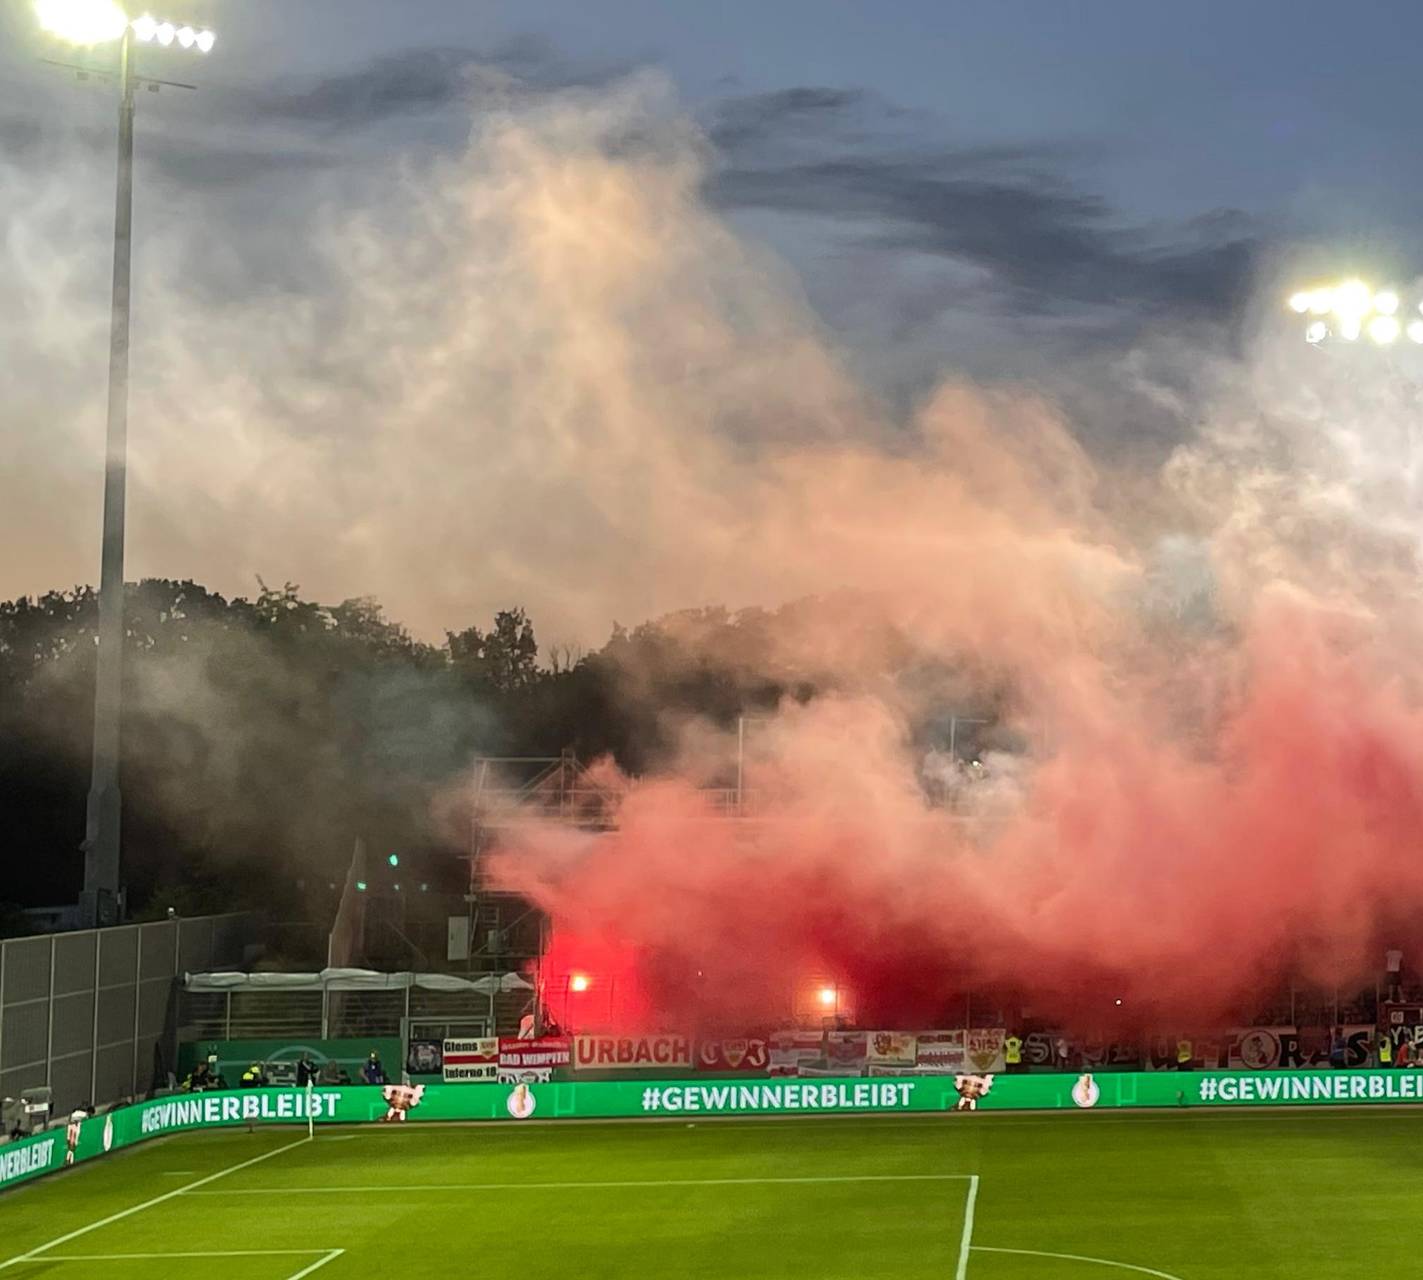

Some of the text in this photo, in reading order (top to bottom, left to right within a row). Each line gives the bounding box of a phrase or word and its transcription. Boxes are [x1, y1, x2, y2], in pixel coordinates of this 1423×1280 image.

[578, 1038, 690, 1064] URBACH
[642, 1083, 915, 1111] #GEWINNERBLEIBT
[141, 1093, 341, 1133] #GEWINNERBLEIBT
